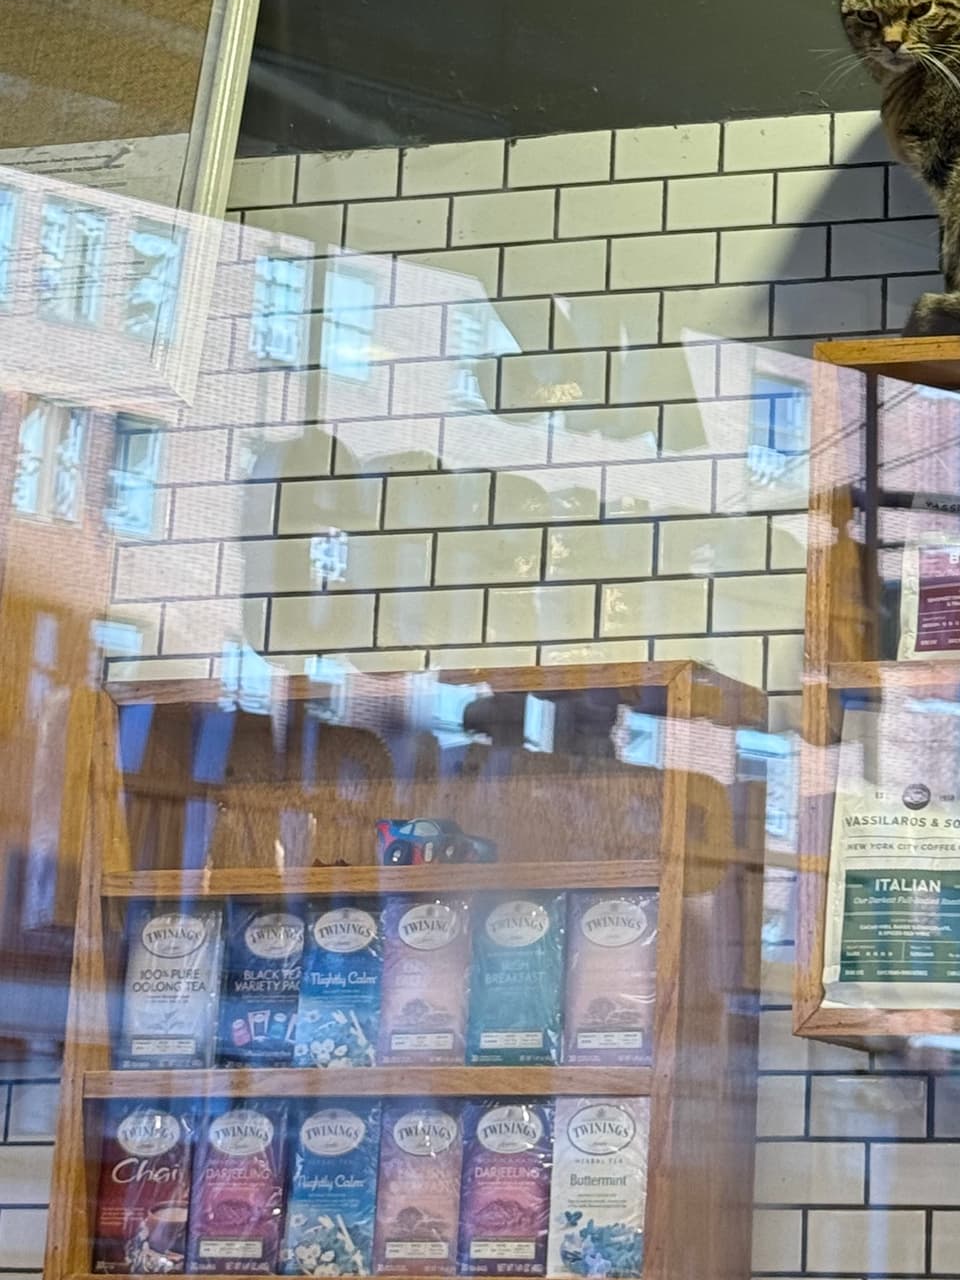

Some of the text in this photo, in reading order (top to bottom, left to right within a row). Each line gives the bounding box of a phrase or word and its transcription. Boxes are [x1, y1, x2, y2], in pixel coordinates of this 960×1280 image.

[844, 816, 926, 829] VASSILAROS
[930, 819, 939, 828] &
[874, 878, 941, 894] ITALIAN
[318, 922, 374, 938] TWININGS
[401, 920, 457, 938] TWININGS
[490, 918, 545, 934] TWININGS
[584, 918, 642, 933] TWININGS
[146, 928, 203, 944] TWININGS
[170, 969, 200, 980] PURE
[244, 970, 279, 980] BLACK
[311, 972, 346, 988] Nightly
[348, 972, 378, 984] Calm
[485, 972, 546, 985] BREAKFAST
[132, 982, 206, 992] OOLONG TEA
[235, 981, 280, 992] VARIETY
[216, 1124, 270, 1142] TWININGS
[304, 1124, 361, 1140] TWININGS
[400, 1124, 452, 1141] TWININGS
[483, 1121, 538, 1140] TWININGS
[574, 1122, 630, 1138] TWININGS
[112, 1158, 180, 1184] Chai
[206, 1168, 270, 1180] DARJEELING
[476, 1167, 540, 1179] DARJEELING
[297, 1174, 364, 1190] Nightly Calm
[570, 1174, 626, 1187] Buttermint
